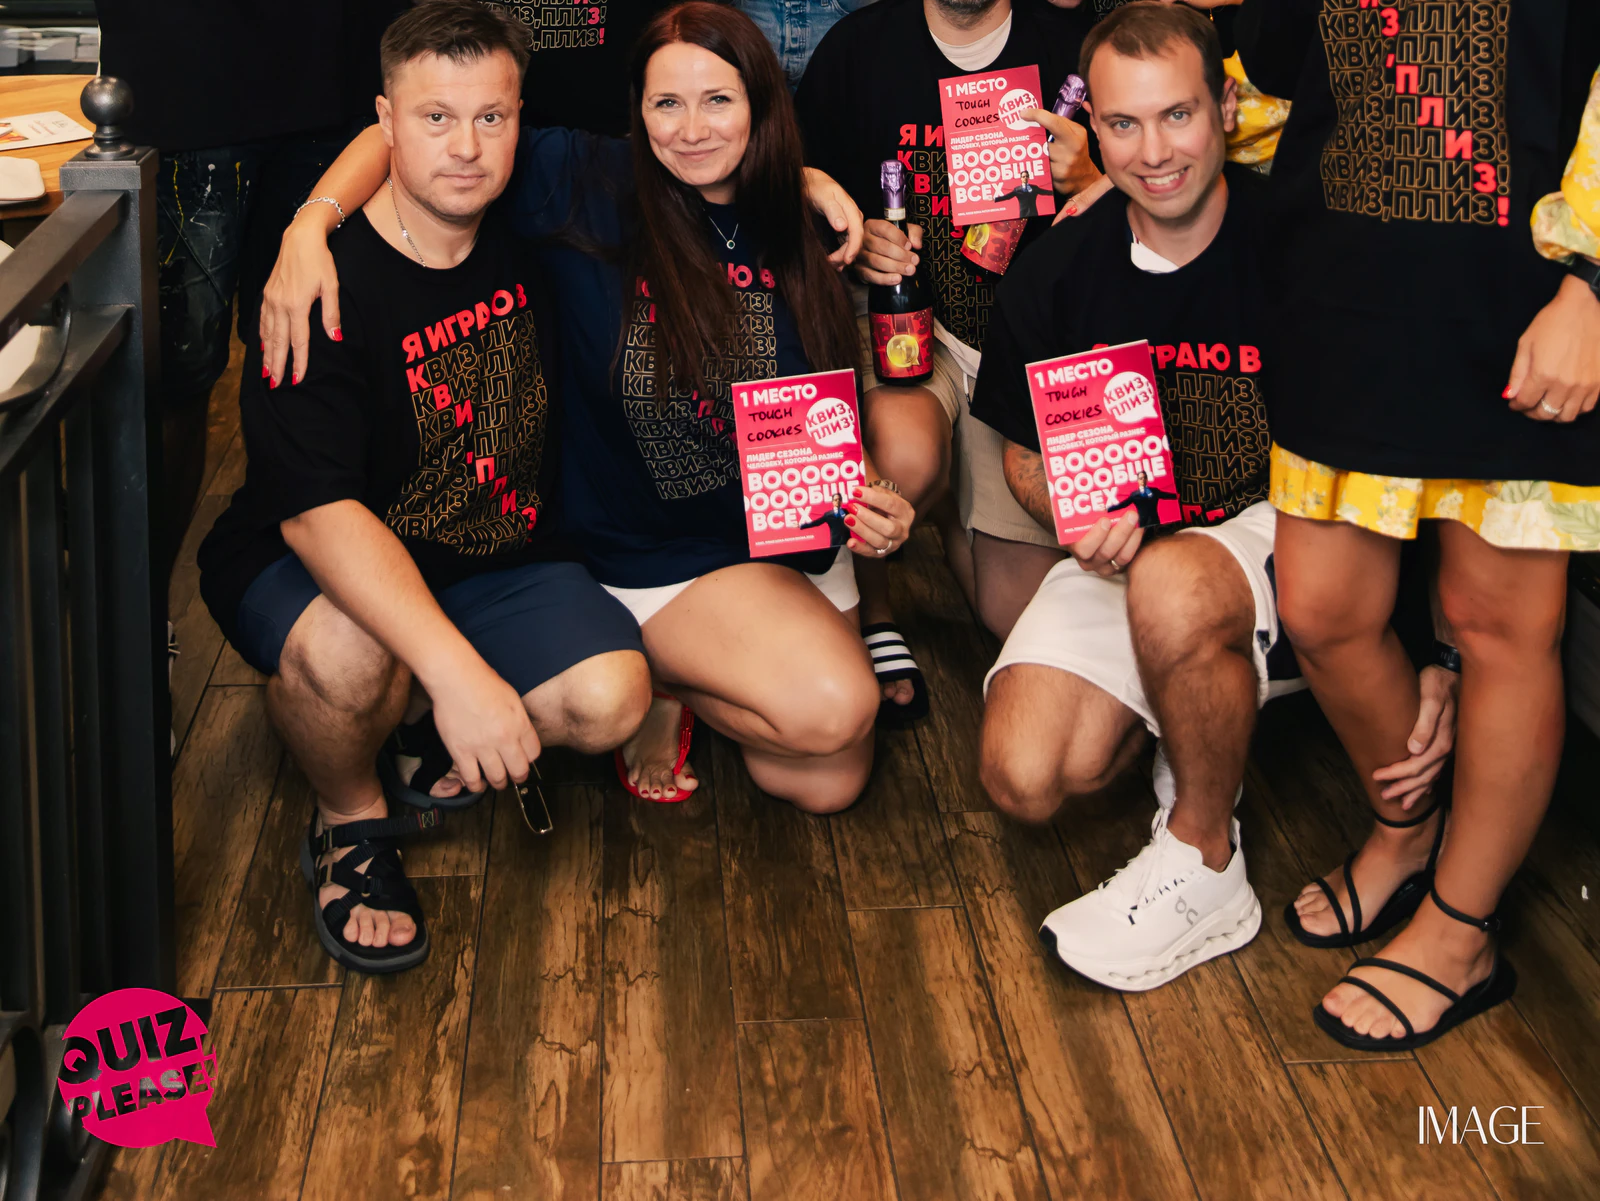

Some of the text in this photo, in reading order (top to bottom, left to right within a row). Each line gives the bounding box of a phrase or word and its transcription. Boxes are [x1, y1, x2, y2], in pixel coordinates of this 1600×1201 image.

[946, 78, 1007, 97] 1 МЕСТО
[899, 123, 917, 146] Я
[951, 132, 1004, 144] ЛИДЕР СЕЗОНА
[956, 182, 1004, 203] ВСЕХ
[402, 331, 424, 364] Я
[1239, 345, 1262, 373] В
[1035, 359, 1112, 387] 1 МЕСТО
[740, 384, 816, 406] 1 МЕСТО
[1047, 425, 1113, 445] ЛИДЕР СЕЗОНА
[747, 448, 812, 462] ЛИДЕР СЕЗОНА
[1058, 487, 1118, 517] ВСЕХ
[752, 506, 812, 531] ВСЕХ
